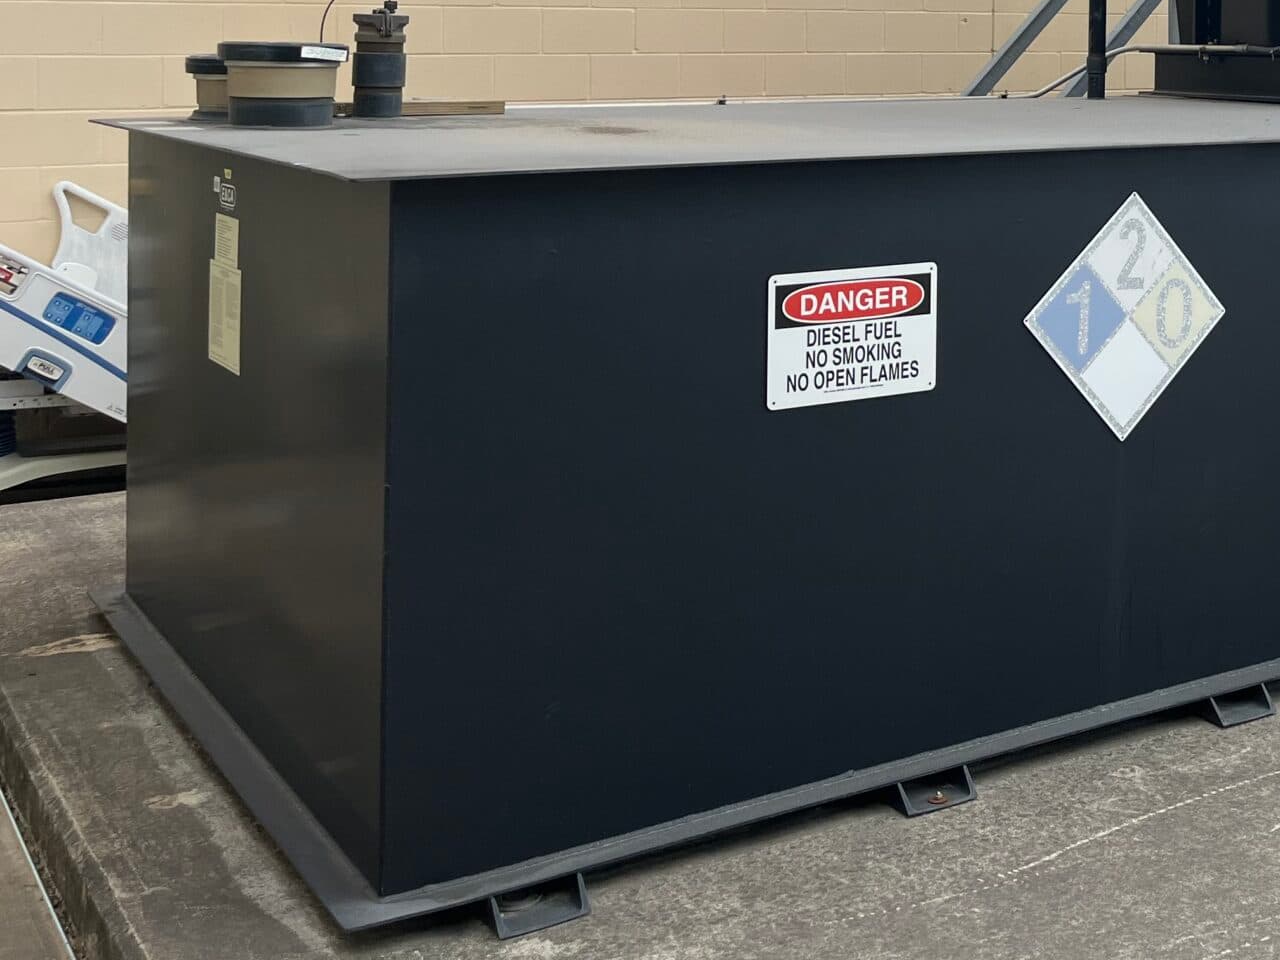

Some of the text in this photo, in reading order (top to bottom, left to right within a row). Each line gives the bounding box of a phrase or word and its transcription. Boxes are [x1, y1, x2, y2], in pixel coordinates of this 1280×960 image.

[1116, 218, 1147, 290] 2
[800, 286, 908, 316] DANGER
[1066, 280, 1091, 355] 1
[1156, 278, 1192, 349] 0
[807, 321, 902, 347] DIESEL FUEL
[806, 341, 902, 369] NO SMOKING
[787, 373, 809, 393] NO
[814, 368, 856, 389] OPEN
[861, 360, 919, 384] FLAMES
